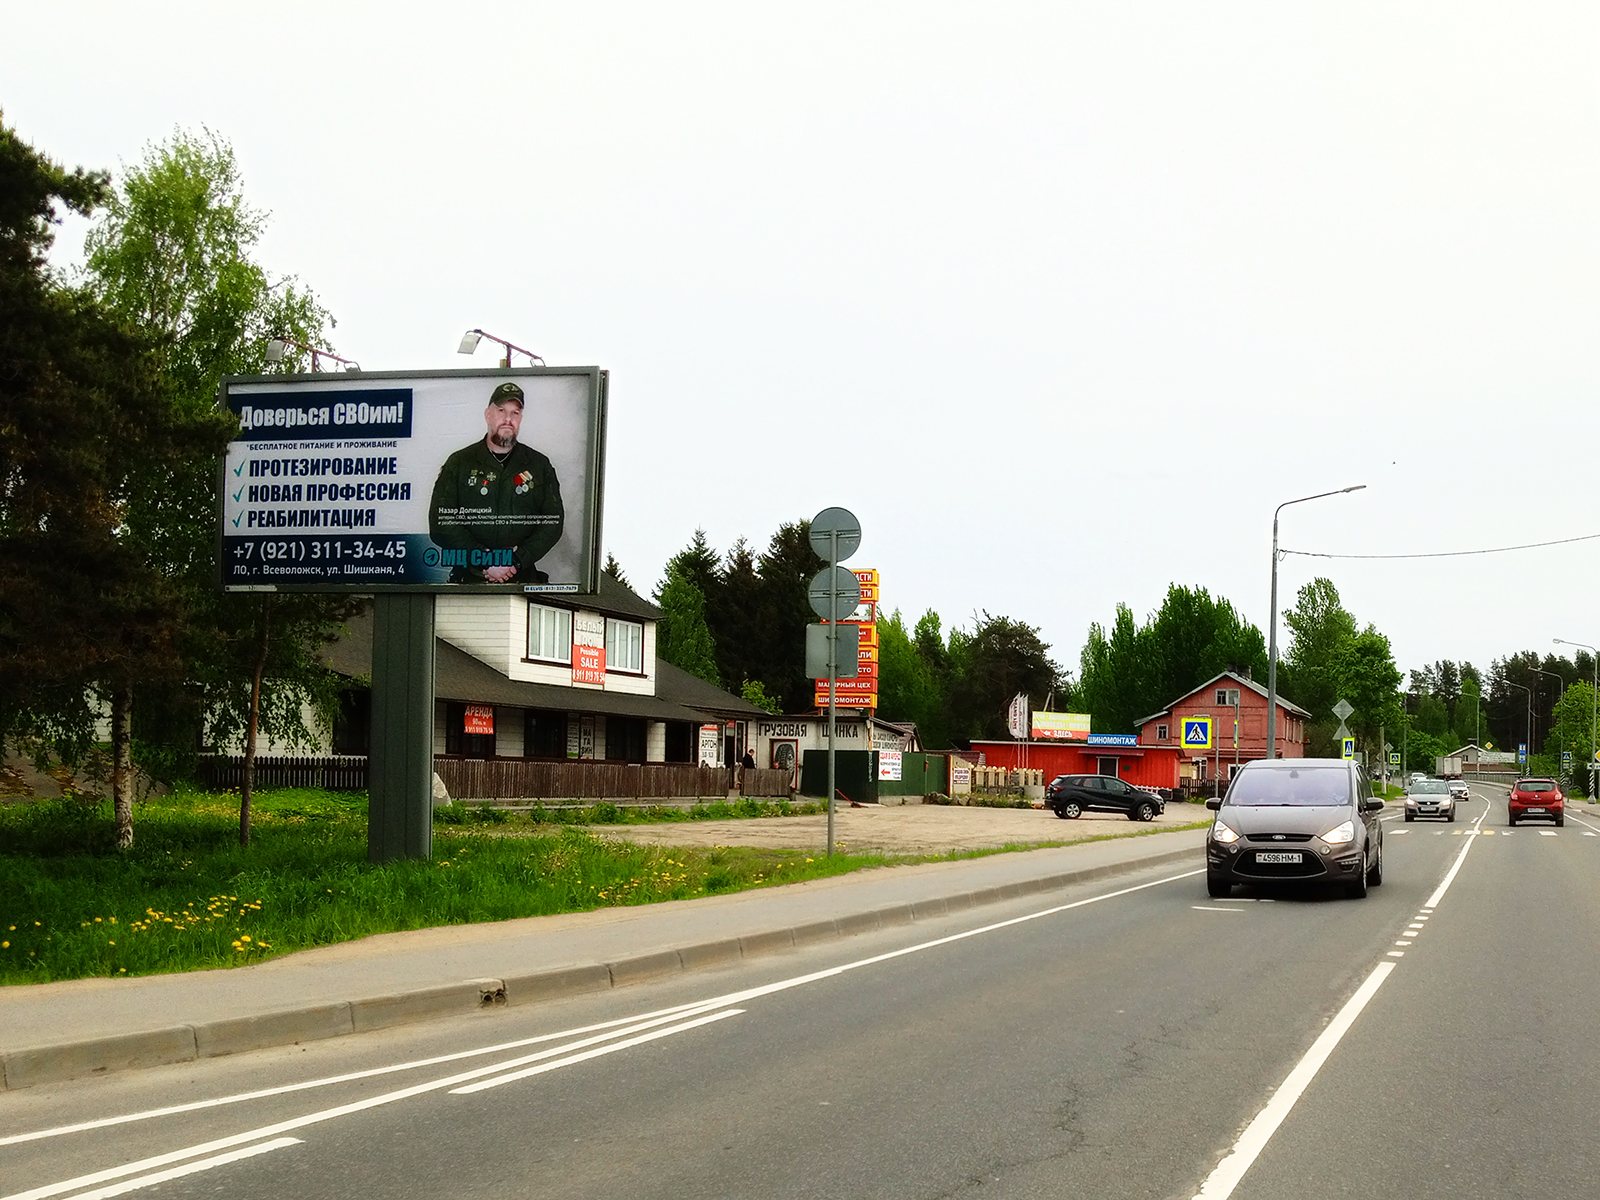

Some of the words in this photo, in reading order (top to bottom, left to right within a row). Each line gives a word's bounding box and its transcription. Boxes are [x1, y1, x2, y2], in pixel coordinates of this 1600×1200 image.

[239, 406, 329, 430] Доверься
[333, 402, 403, 425] СВОим!
[343, 441, 397, 449] ПРОЖИВАНИЕ
[249, 457, 397, 477] ПРОТЕЗИРОВАНИЕ
[248, 484, 302, 502] НОВАЯ
[306, 483, 411, 501] ПРОФЕССИЯ
[438, 507, 458, 515] Назар
[247, 509, 376, 529] РЕАБИЛИТАЦИЯ
[233, 542, 255, 559] +7
[260, 541, 306, 562] (921)
[311, 541, 406, 561] 311-34-45
[442, 549, 466, 568] МЦ
[233, 565, 250, 576] ЛО,
[252, 566, 261, 575] г.
[262, 564, 324, 576] Всеволожск,
[326, 567, 340, 576] ул.
[343, 564, 396, 575] Шишканя,
[398, 564, 404, 574] 4
[580, 657, 599, 669] SALE
[465, 706, 493, 719] АРЕНДА
[758, 723, 807, 738] ГРУЗОВАЯ
[1088, 736, 1136, 745] ШИНОМОНТАЖ
